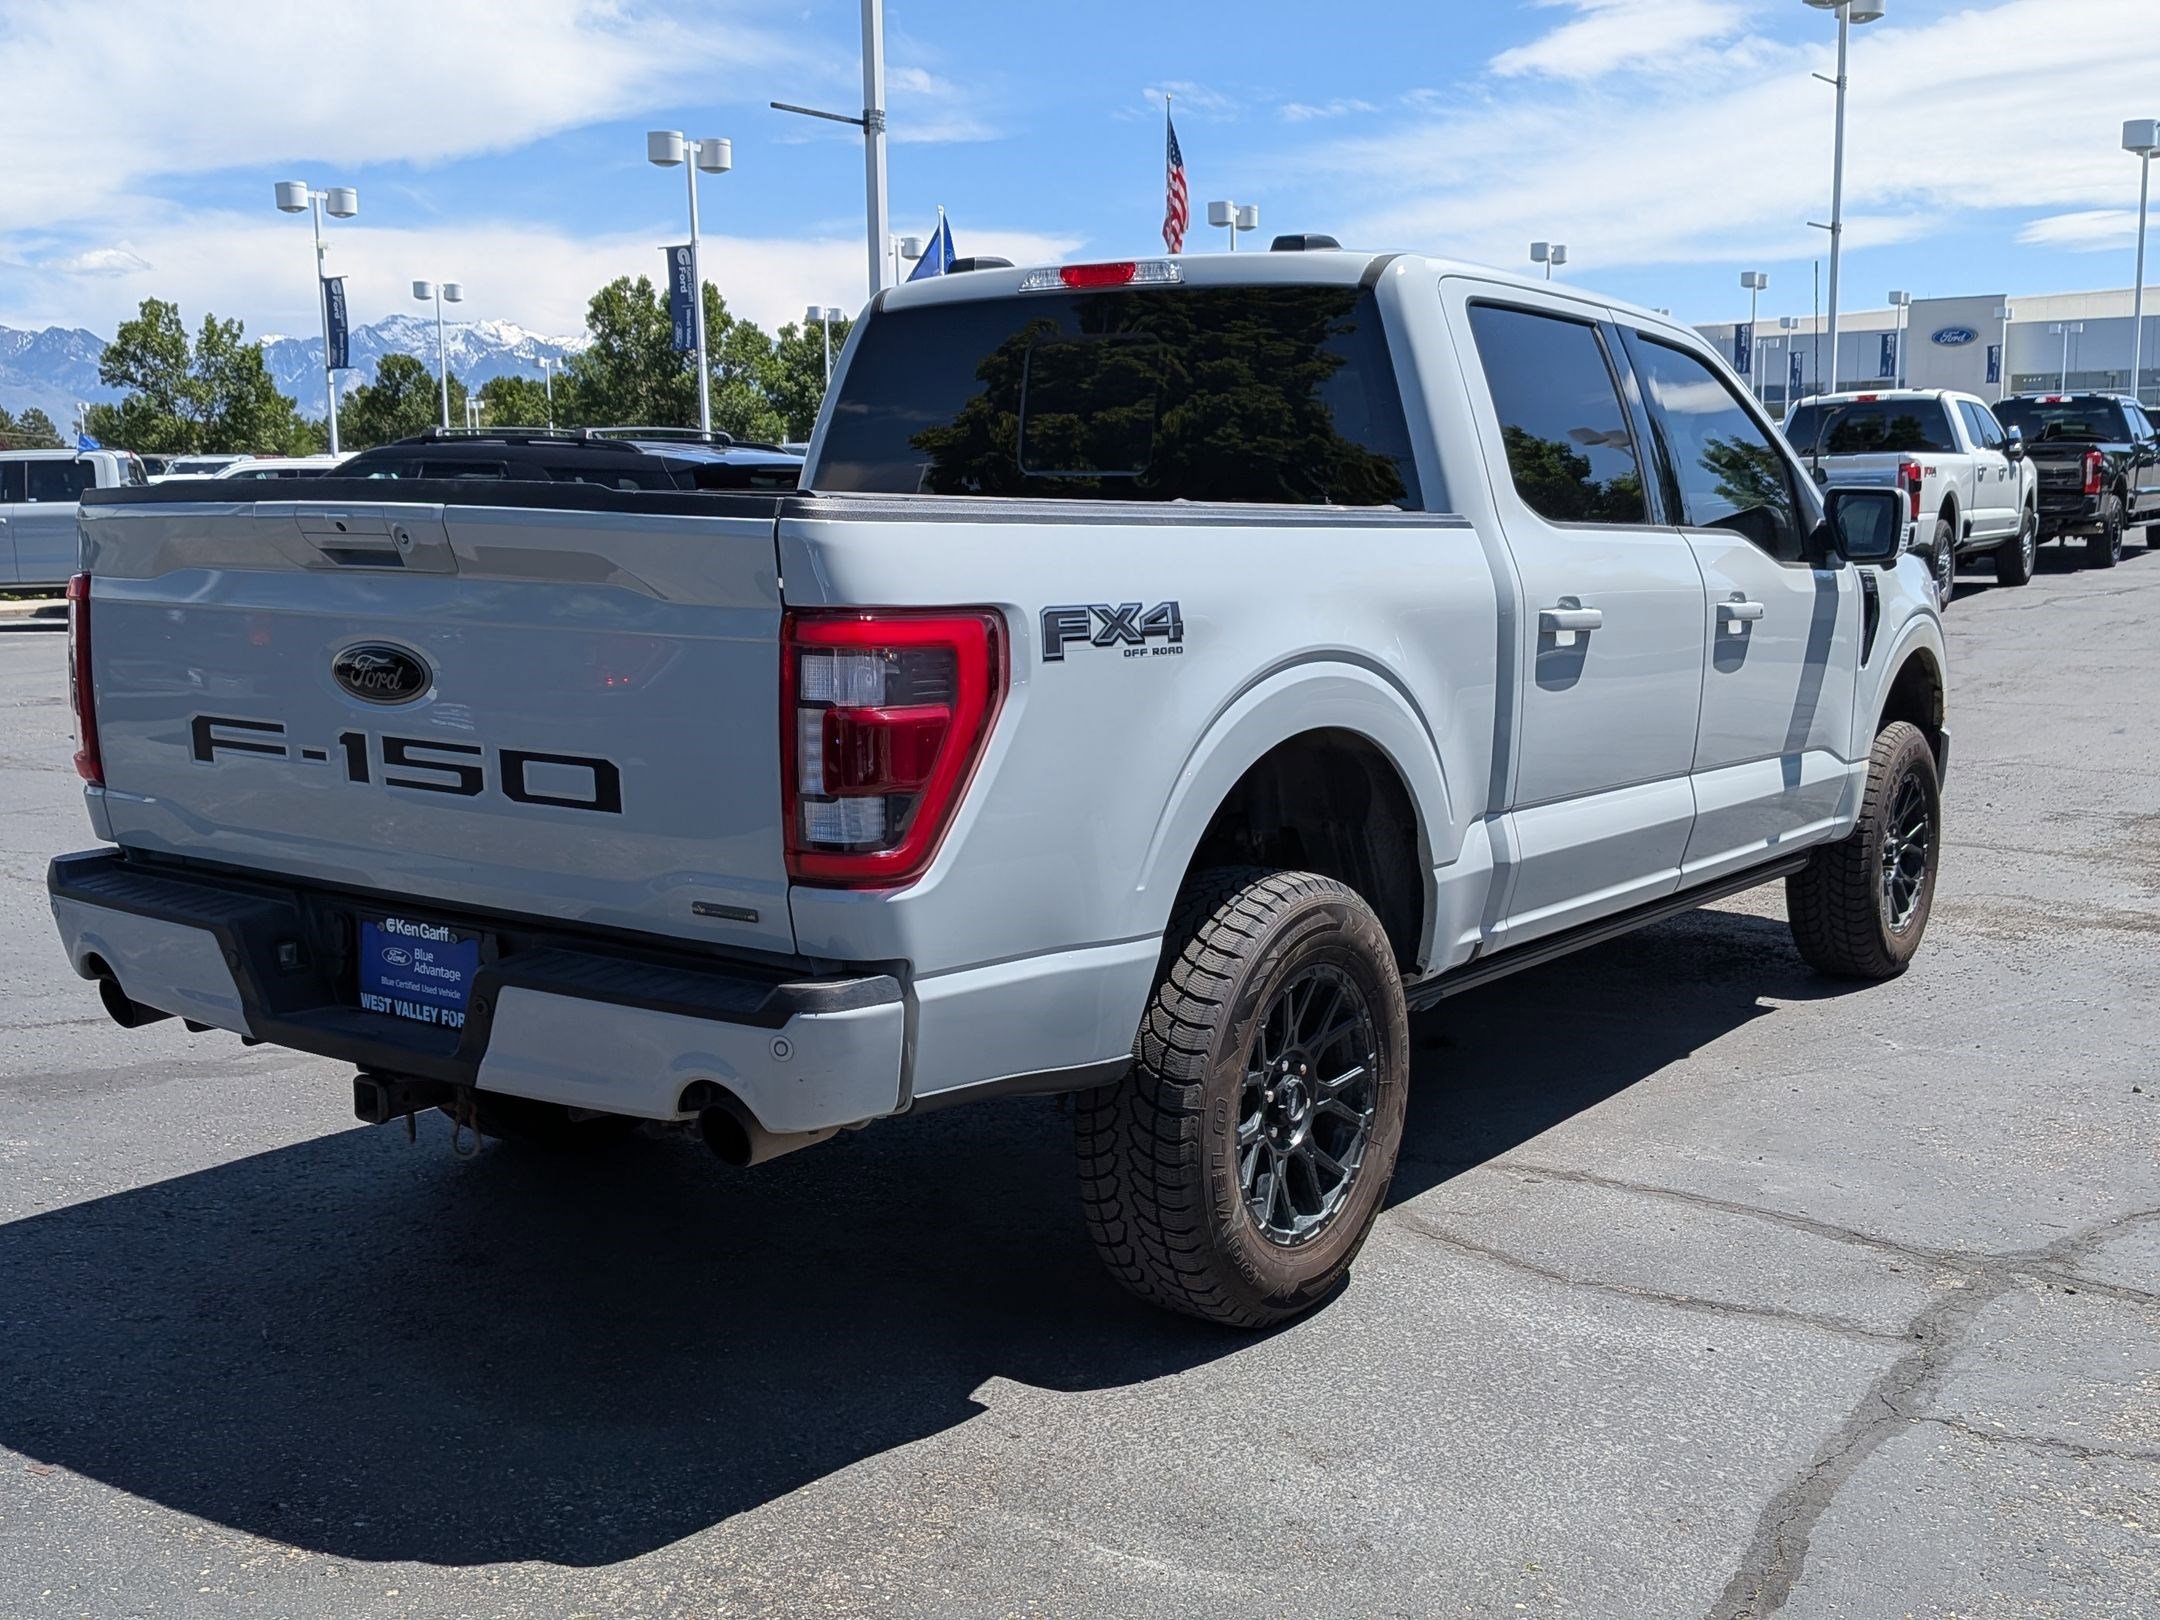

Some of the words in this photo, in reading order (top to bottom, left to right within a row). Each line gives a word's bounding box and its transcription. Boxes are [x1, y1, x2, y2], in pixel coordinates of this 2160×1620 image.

[678, 266, 688, 293] Ford
[332, 296, 340, 319] Ford
[1940, 330, 1967, 343] Ford
[1040, 601, 1184, 663] FX4
[1124, 648, 1148, 658] OFF
[1152, 646, 1184, 656] ROAD
[351, 654, 402, 690] Ford
[191, 714, 622, 814] F-150
[396, 919, 419, 938] Ken
[420, 923, 449, 942] Garff
[387, 949, 407, 963] Ford
[414, 948, 434, 962] Blue
[413, 962, 461, 981] Advantage
[381, 976, 394, 987] Blue
[395, 979, 420, 991] Certified
[421, 984, 437, 995] Used
[438, 987, 461, 999] Vehicle
[361, 992, 392, 1014] WEST
[394, 1000, 438, 1022] VALLEY
